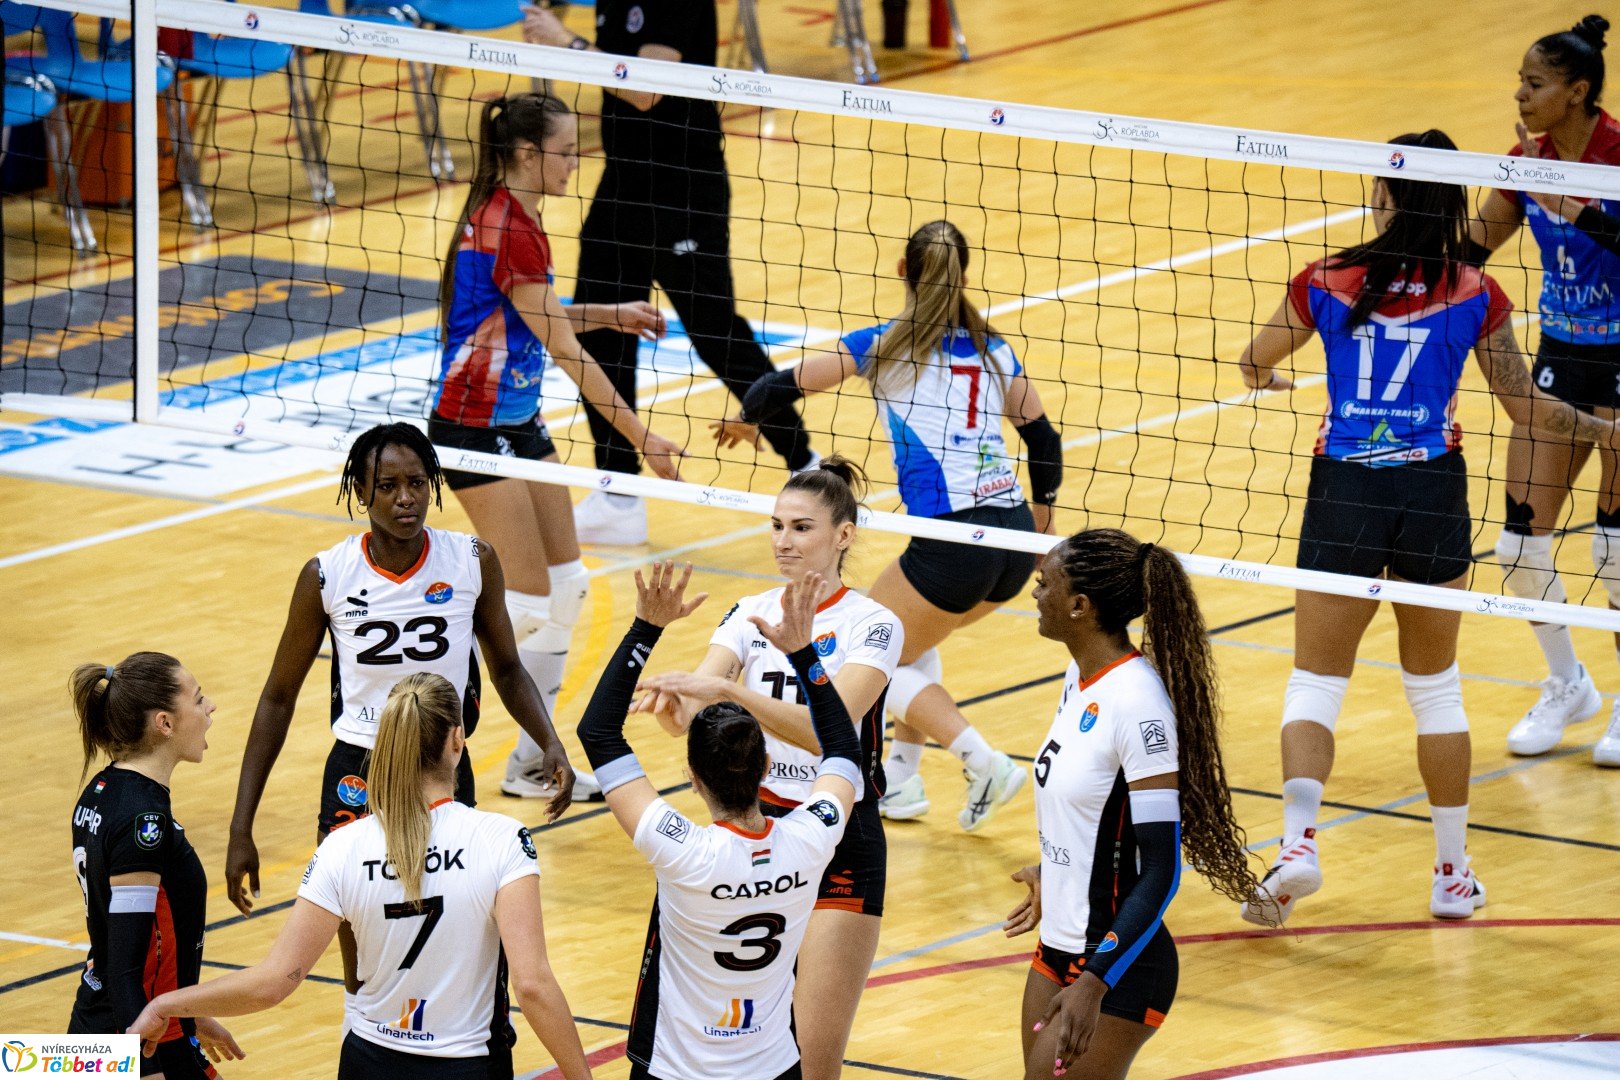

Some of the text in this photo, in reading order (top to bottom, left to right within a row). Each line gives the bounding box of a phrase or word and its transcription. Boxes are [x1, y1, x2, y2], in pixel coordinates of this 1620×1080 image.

[469, 43, 518, 65] FATUM
[842, 90, 892, 112] FATUM
[1236, 135, 1289, 157] FATUM
[1352, 325, 1431, 402] 17
[1537, 366, 1555, 388] 6
[950, 365, 981, 429] 7
[458, 454, 499, 472] FATUM
[1220, 563, 1261, 578] FATUM
[345, 608, 368, 618] nine
[354, 616, 450, 665] 23
[1034, 739, 1061, 788] 5
[362, 846, 466, 881] TÖÖK
[711, 872, 808, 899] CAROL
[384, 895, 443, 971] 7
[714, 913, 786, 971] 3
[377, 1022, 434, 1042] Linartech
